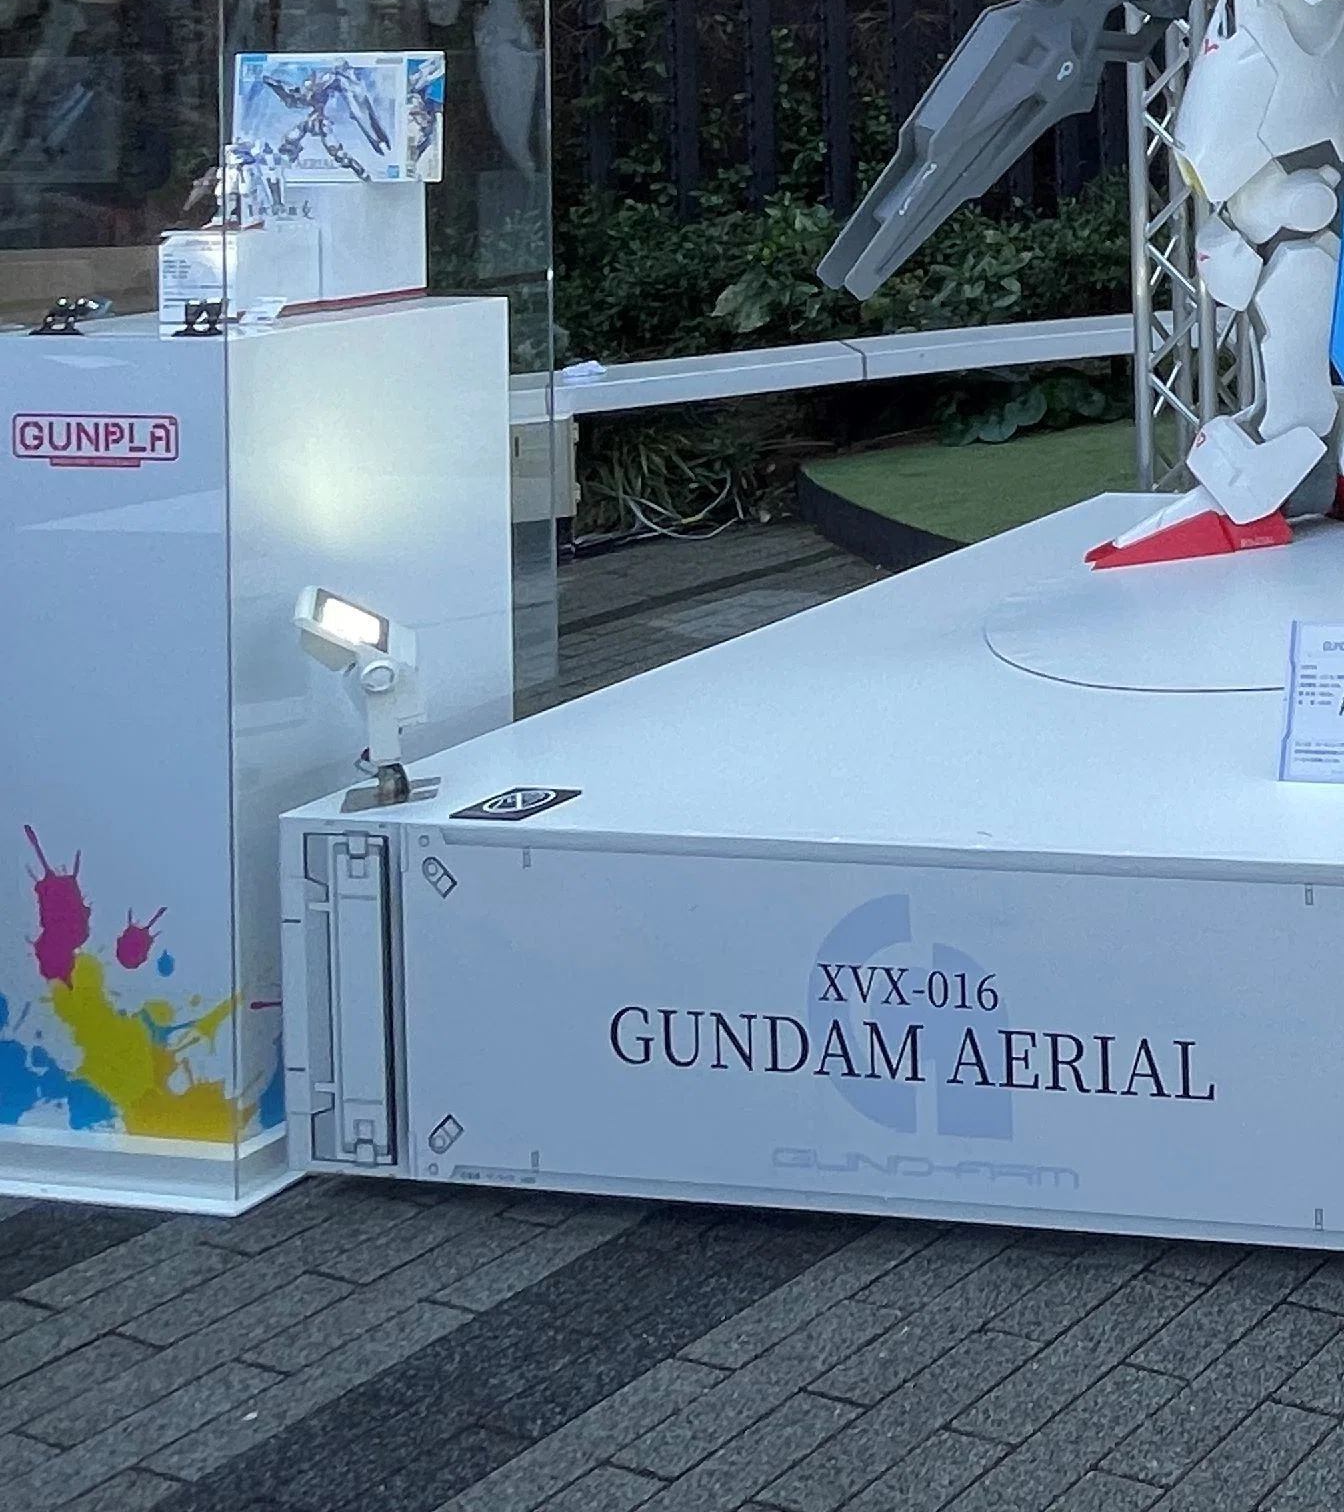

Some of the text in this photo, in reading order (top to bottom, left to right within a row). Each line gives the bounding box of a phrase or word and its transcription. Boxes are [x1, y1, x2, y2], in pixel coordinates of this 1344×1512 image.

[18, 420, 172, 453] GUNPLA
[817, 961, 999, 1012] XVX-016
[609, 1005, 1217, 1102] GUNDAM AERIAL
